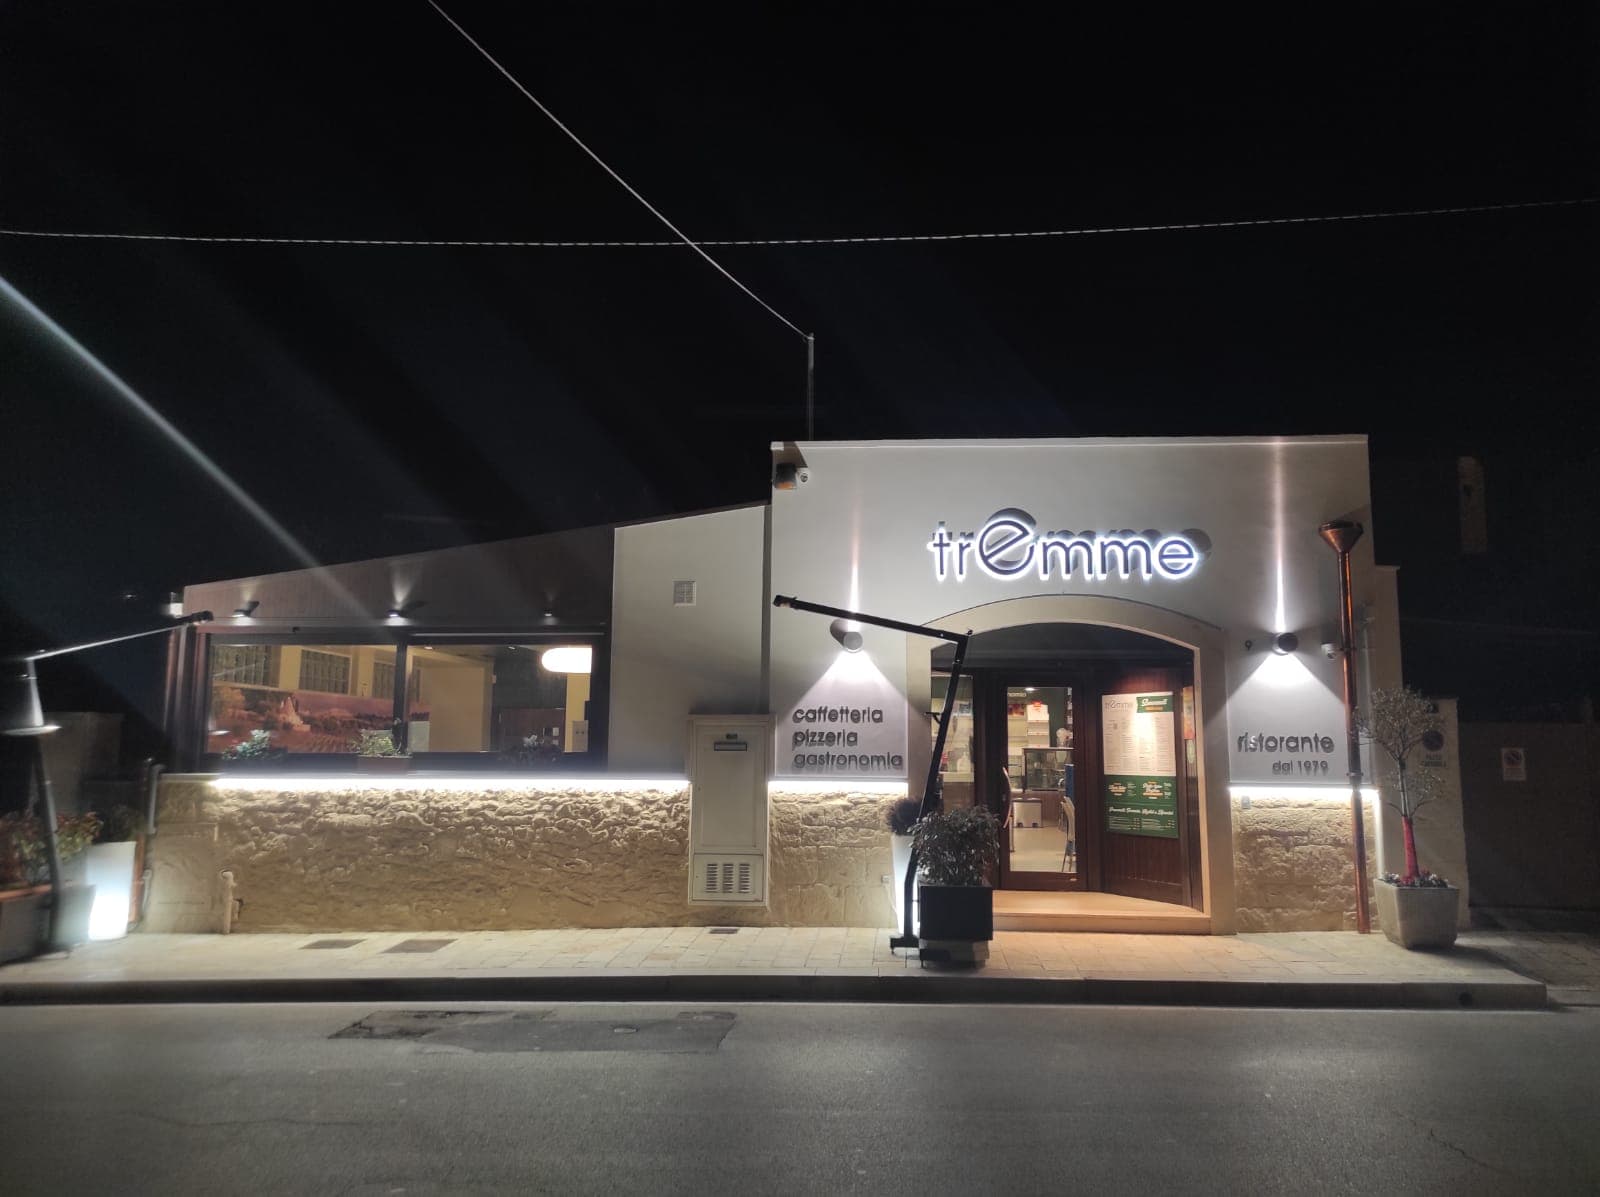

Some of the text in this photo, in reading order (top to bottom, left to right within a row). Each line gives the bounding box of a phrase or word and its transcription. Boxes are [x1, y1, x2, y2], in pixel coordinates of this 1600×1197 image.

[929, 519, 1198, 578] tremme
[792, 706, 884, 723] caffetteria
[792, 729, 859, 751] pizzeria
[1237, 732, 1335, 754] ristorante
[792, 751, 904, 771] gastronomia
[1271, 760, 1329, 776] dal 1979
